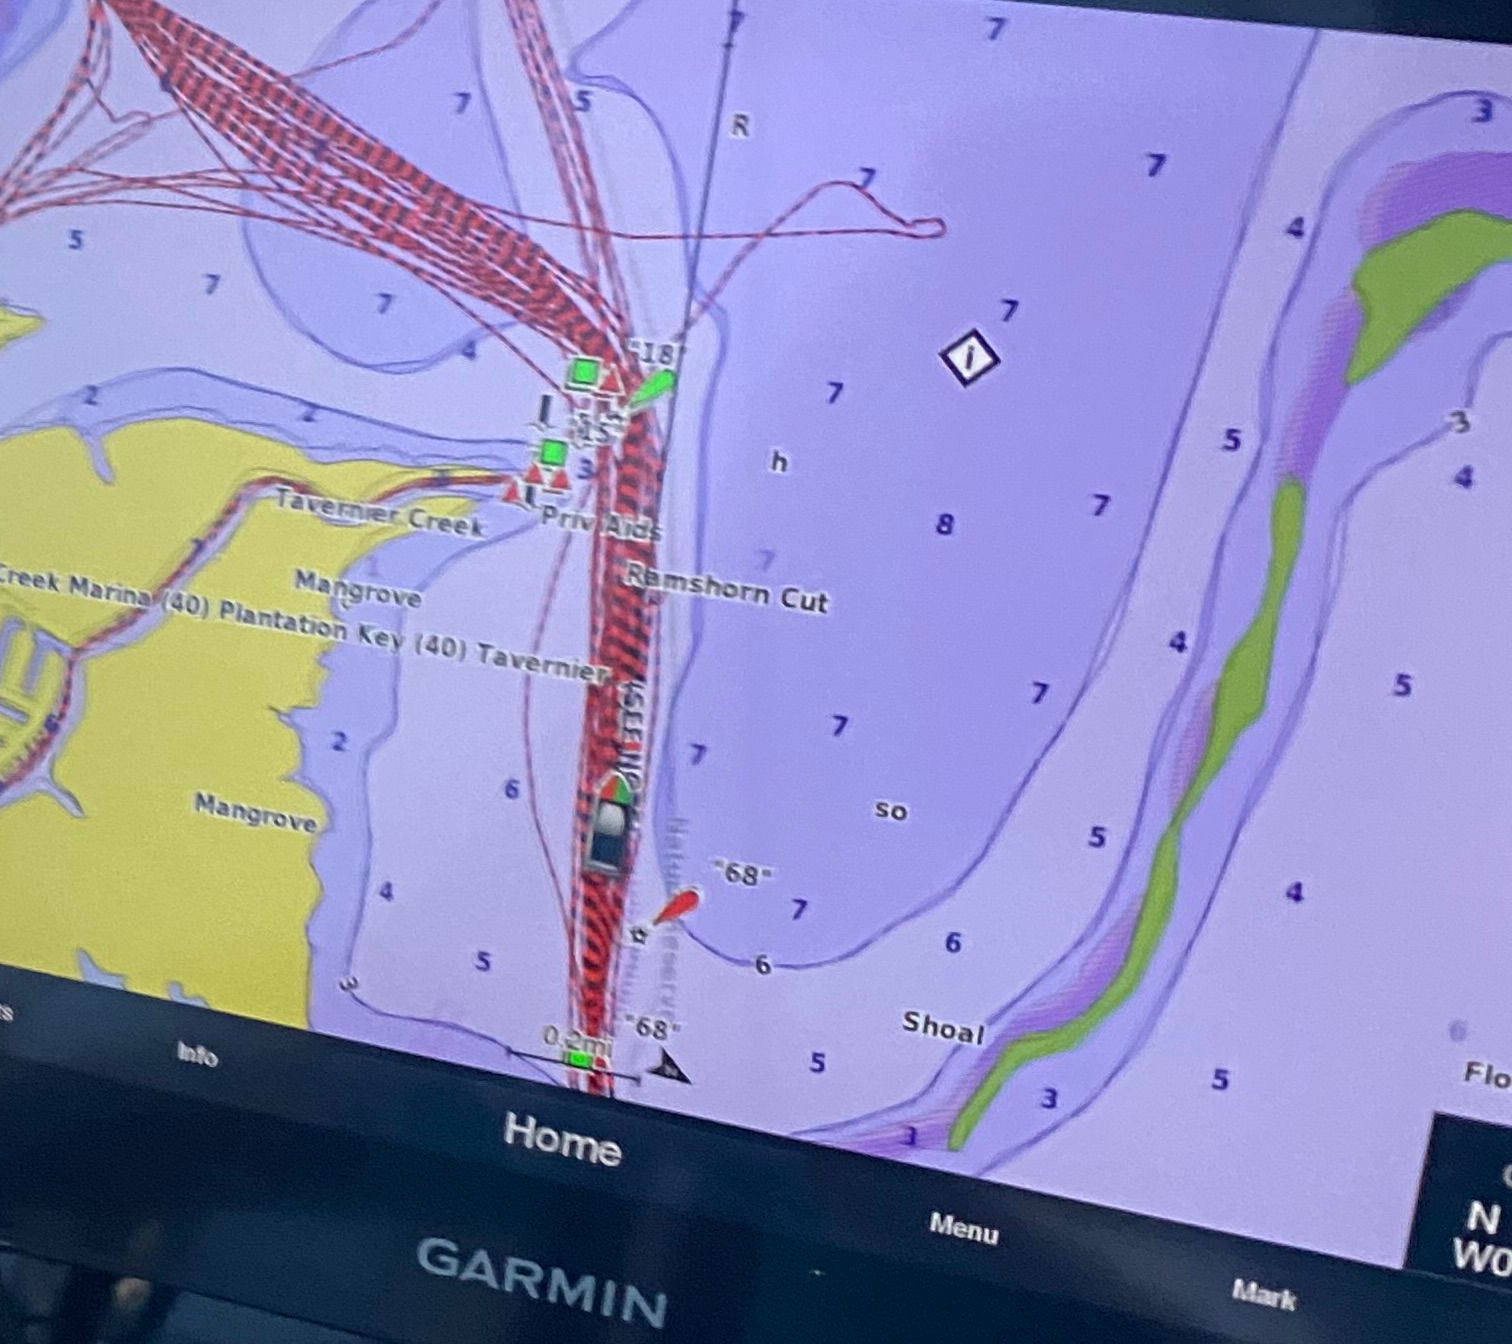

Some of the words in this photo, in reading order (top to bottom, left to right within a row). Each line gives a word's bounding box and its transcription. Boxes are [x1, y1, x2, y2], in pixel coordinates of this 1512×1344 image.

[985, 17, 1008, 40] 7
[454, 92, 472, 114] 7
[1471, 99, 1494, 123] 3
[732, 114, 749, 137] R
[1145, 152, 1168, 177] 7
[1285, 215, 1305, 239] 4
[69, 229, 84, 250] 5
[203, 274, 221, 294] 7
[376, 293, 395, 314] 7
[1000, 299, 1020, 322] 7
[826, 382, 843, 404] 7
[1449, 410, 1471, 434] 3
[1222, 429, 1242, 451] 5
[771, 450, 788, 473] h
[1454, 464, 1474, 489] 4
[277, 488, 398, 522] Tavernier
[410, 509, 484, 537] Creek
[1092, 494, 1111, 517] 7
[541, 506, 595, 530] Priv
[936, 513, 955, 535] 8
[295, 569, 423, 609] Mangrove
[627, 563, 769, 603] Ramshorn
[782, 588, 828, 613] Cut
[68, 575, 154, 607] Marina
[162, 593, 210, 619] (40)
[220, 600, 347, 640] Plantation
[359, 624, 404, 653] Key
[415, 634, 467, 661] (40)
[478, 643, 611, 685] Tavernier
[1169, 630, 1188, 654] 4
[1032, 681, 1050, 705] 7
[1394, 673, 1413, 697] 5
[833, 715, 848, 736] 7
[332, 731, 347, 752] 2
[690, 743, 707, 764] 7
[504, 779, 519, 799] 6
[195, 791, 317, 833] Mangrove
[876, 800, 908, 821] so
[1089, 826, 1106, 849] 5
[380, 881, 394, 902] 4
[1286, 882, 1304, 904] 4
[791, 899, 808, 920] 7
[946, 933, 962, 953] 6
[476, 951, 492, 972] 5
[755, 954, 771, 975] 6
[903, 1009, 985, 1046] Shoal
[178, 1041, 218, 1068] Info
[809, 1052, 825, 1074] 5
[1212, 1068, 1229, 1092] 5
[1042, 1088, 1058, 1109] 3
[504, 1110, 622, 1167] Home
[930, 1211, 999, 1246] Menu
[1467, 1200, 1501, 1235] N
[417, 1236, 667, 1330] GARMIN
[1232, 1278, 1296, 1311] Mark
